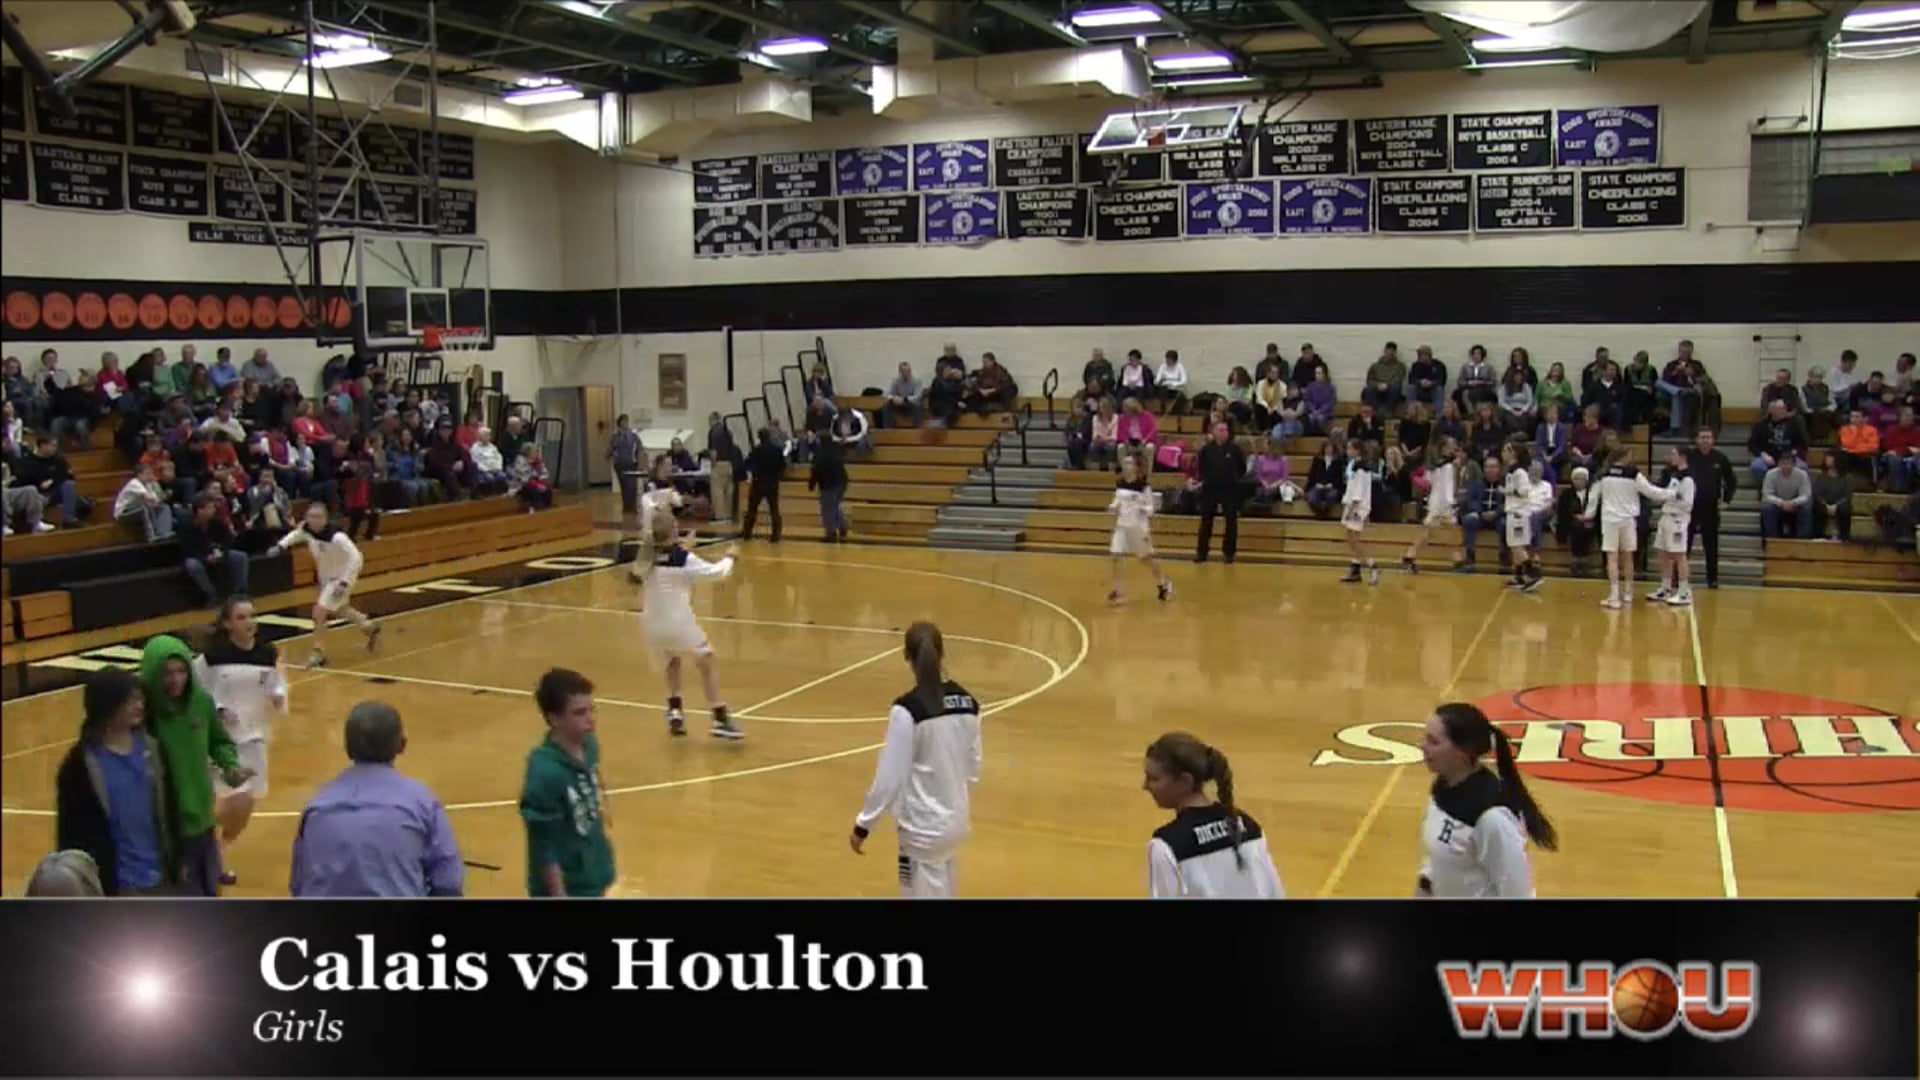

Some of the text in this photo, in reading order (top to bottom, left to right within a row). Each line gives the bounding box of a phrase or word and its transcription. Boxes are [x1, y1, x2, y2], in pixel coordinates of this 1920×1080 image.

[1461, 115, 1545, 128] STATE CHAMPIONS
[1267, 124, 1309, 135] EASTERN
[1458, 128, 1547, 142] BOYS BASKETBALL
[1273, 134, 1334, 145] CHAMPIONS
[1369, 129, 1434, 142] CHAMPIONS
[995, 137, 1040, 149] EASTERN
[1386, 141, 1417, 150] 2004
[1477, 143, 1515, 153] CLASS
[1564, 139, 1587, 150] EAST
[1007, 146, 1062, 160] CHAMPIONS
[1386, 149, 1443, 159] BASKETBALL
[1188, 160, 1223, 169] CLASS
[1378, 160, 1415, 169] CLASS
[1486, 155, 1518, 165] 2004
[1280, 164, 1317, 172] CLASS
[1481, 174, 1572, 187] STATE RUNNERS-UP
[1588, 172, 1676, 186] STATE CHAMPIONS
[1383, 179, 1465, 192] STATE CHAMPIONS
[1381, 193, 1468, 205] CHEERLEADING
[1588, 187, 1677, 200] CHEERLEADING
[1018, 200, 1073, 211] CHAMPIONS
[1100, 201, 1174, 215] CHEERLEADING
[1510, 198, 1542, 208] 2004
[1606, 202, 1646, 212] CLASS
[1192, 209, 1213, 219] EAST
[1285, 207, 1305, 217] EAST
[1399, 207, 1437, 217] CLASS
[1495, 207, 1558, 218] SOFTBALL
[1114, 216, 1149, 226] CLASS
[1408, 219, 1439, 228] 2004
[1501, 217, 1539, 227] CLASS
[1310, 713, 1920, 767] HIRES
